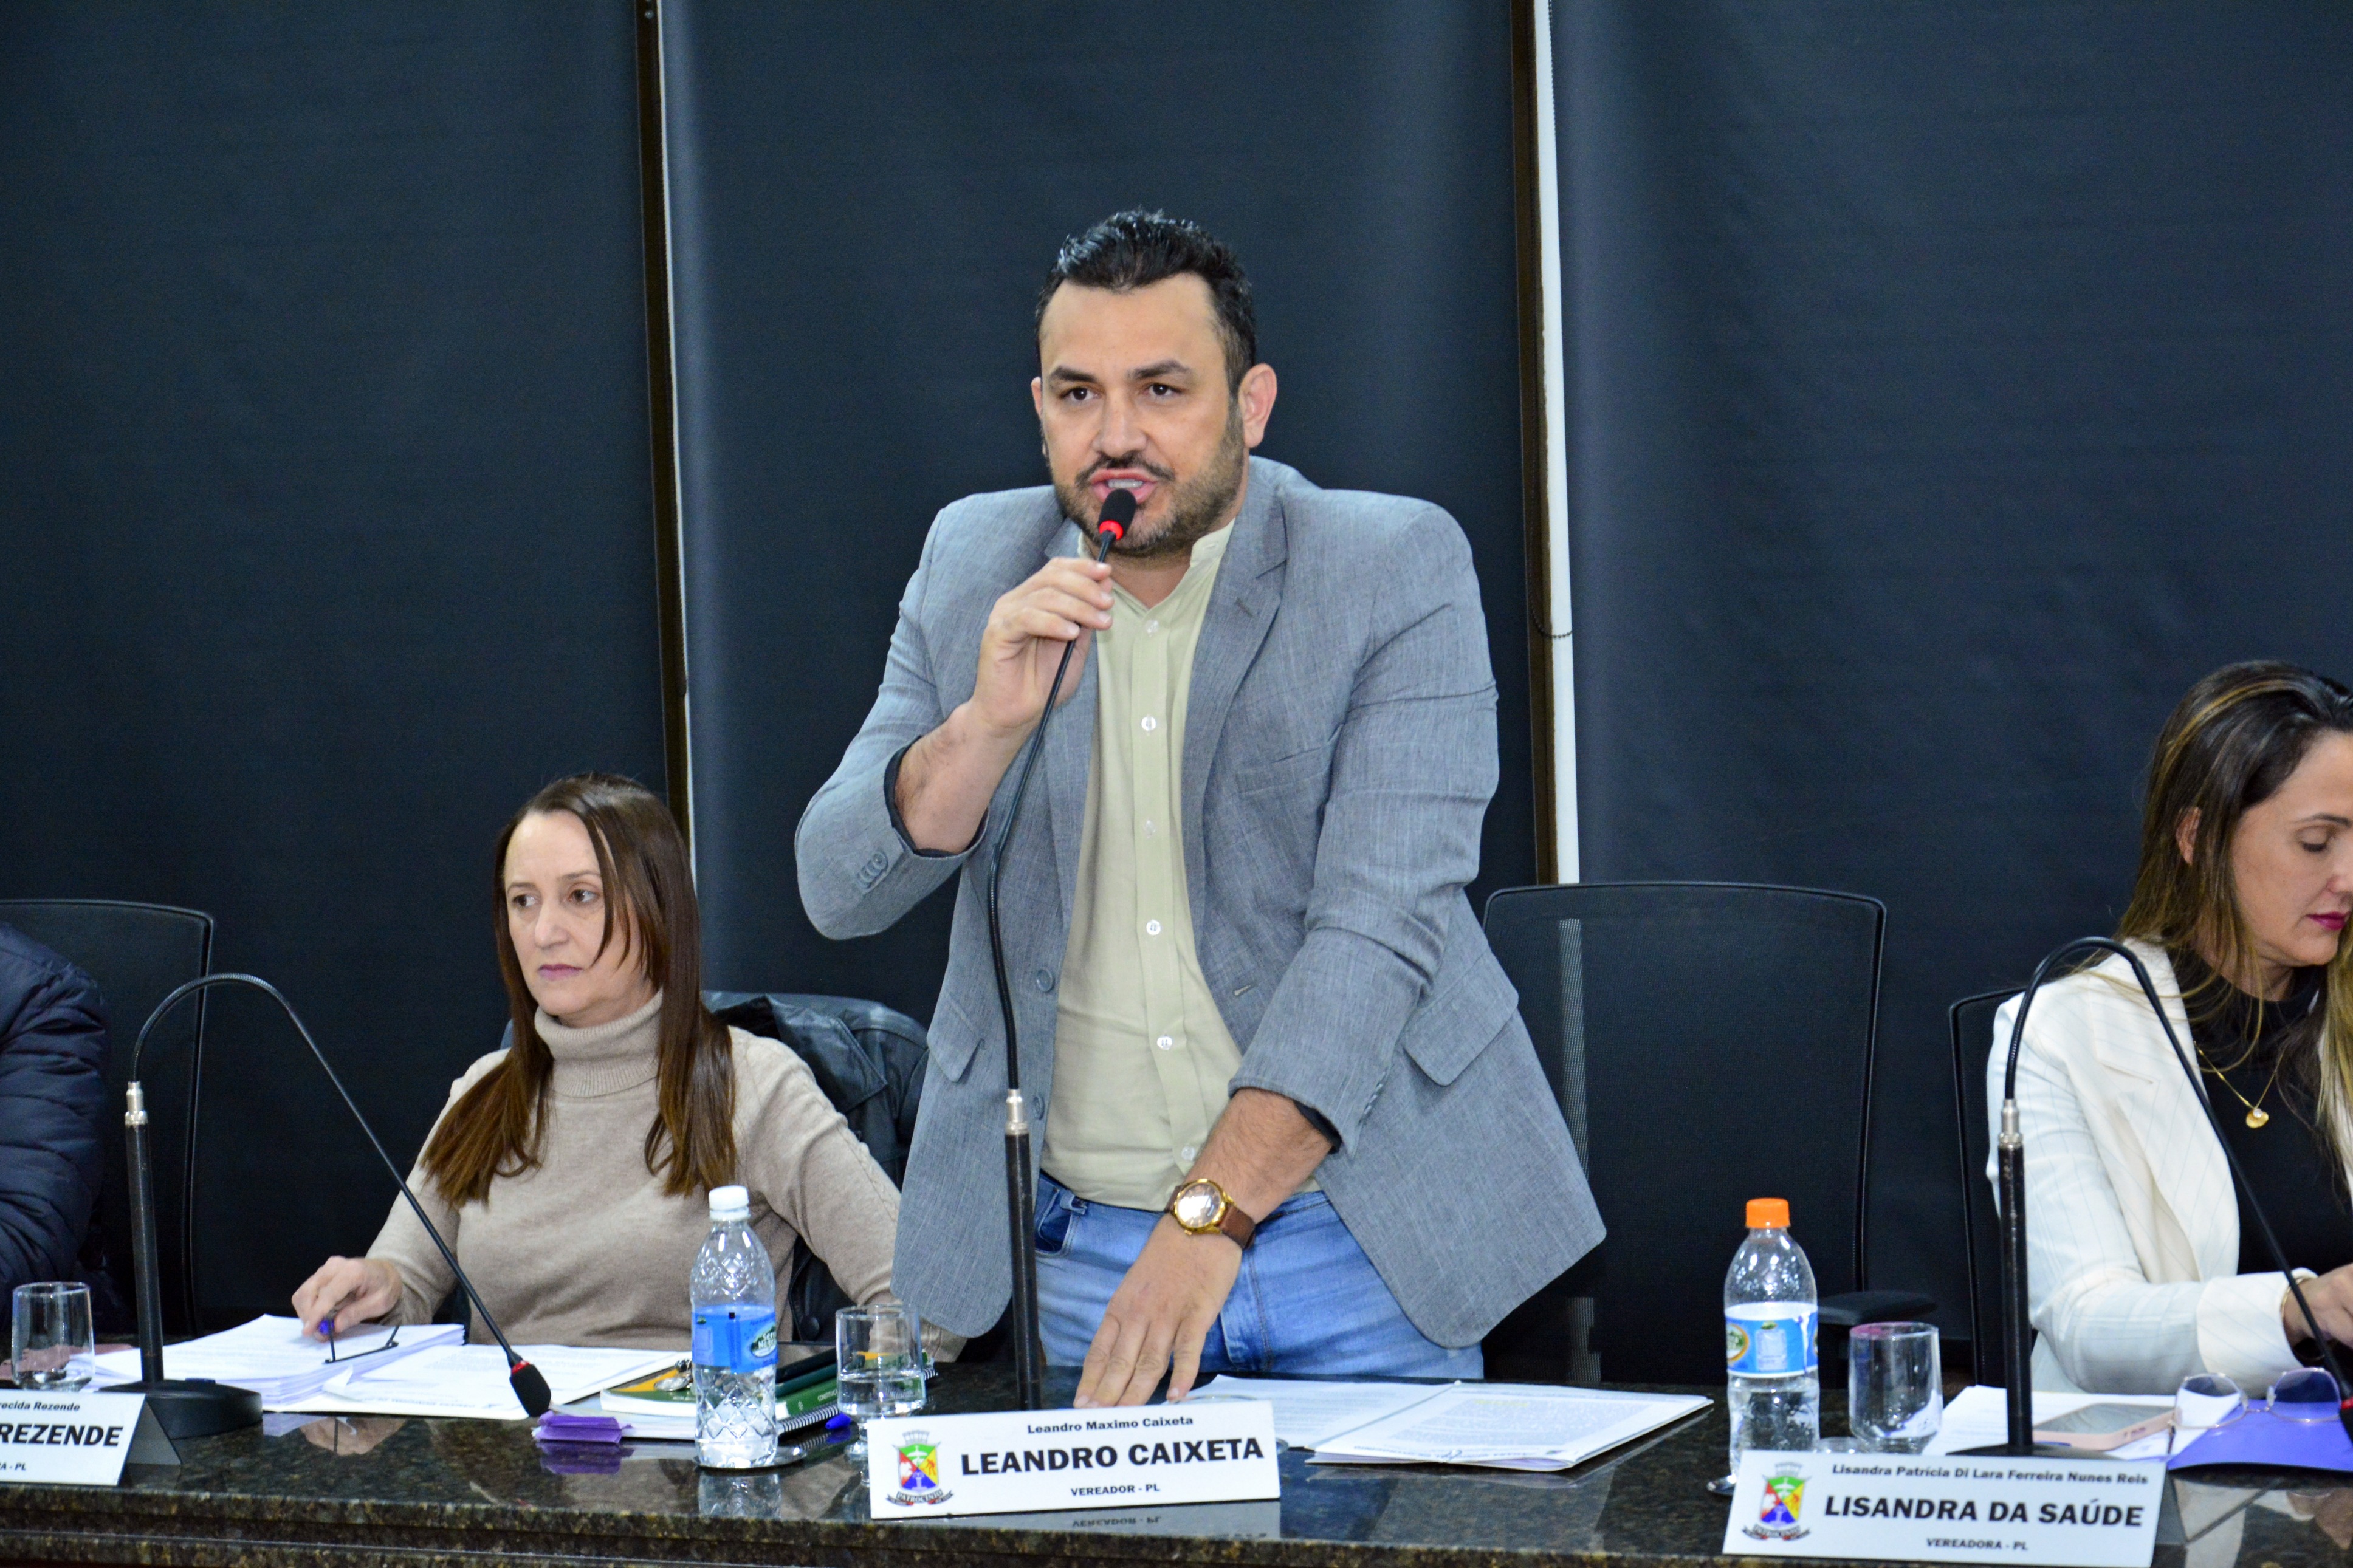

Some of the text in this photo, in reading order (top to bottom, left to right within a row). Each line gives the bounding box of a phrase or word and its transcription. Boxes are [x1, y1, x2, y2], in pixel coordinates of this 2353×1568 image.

[33, 1402, 80, 1411] Rezende
[1028, 1416, 1194, 1434] Leandro Maximo Caixeta
[0, 1423, 123, 1447] REZENDE
[961, 1437, 1264, 1476] LEANDRO CAIXETA
[15, 1462, 26, 1471] PL
[1832, 1464, 1892, 1476] Lisandra
[1954, 1468, 1969, 1478] Di
[1973, 1468, 2004, 1479] Lara
[2008, 1470, 2063, 1481] Ferreira
[2067, 1472, 2112, 1483] Nunes
[2117, 1473, 2148, 1484] Reis
[1070, 1485, 1135, 1496] VEREADOR
[1145, 1484, 1159, 1492] PL
[1825, 1496, 2143, 1527] LISANDRA DA SAÚDE
[1926, 1538, 2002, 1549] VEREADORA
[2013, 1541, 2027, 1550] PL
